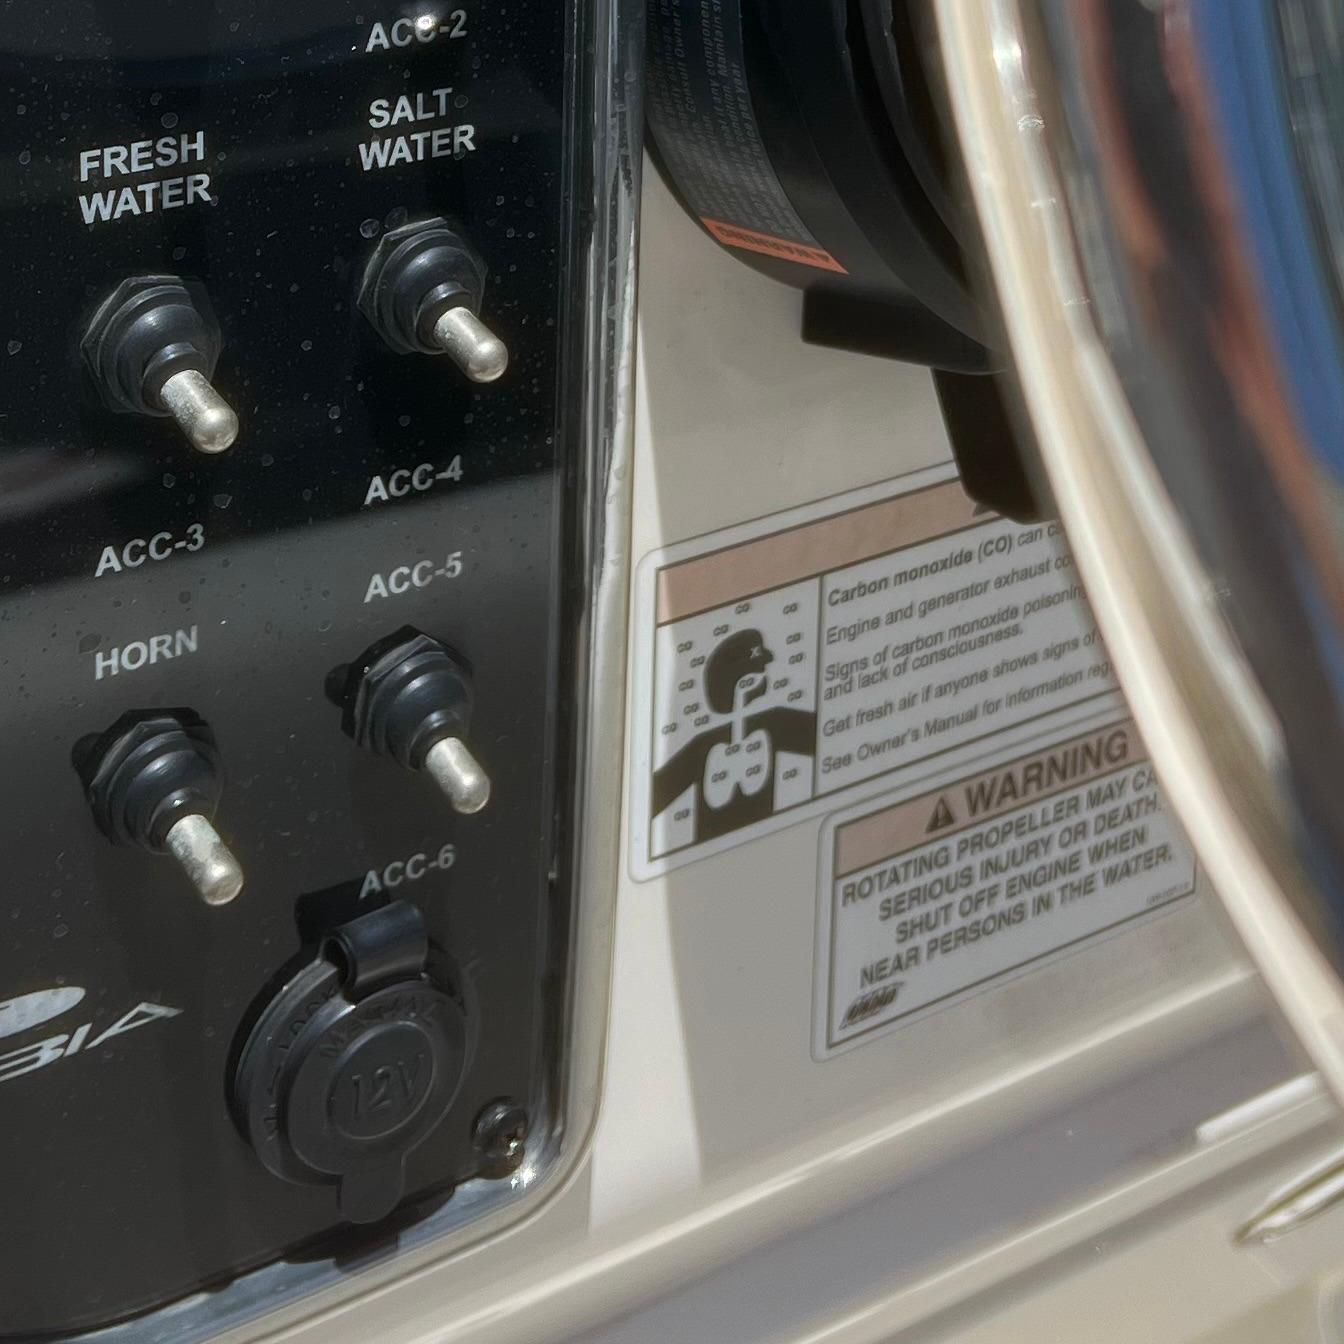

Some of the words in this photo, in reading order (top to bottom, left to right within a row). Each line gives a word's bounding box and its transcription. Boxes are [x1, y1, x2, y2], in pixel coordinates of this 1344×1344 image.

[365, 8, 469, 53] ACC-2
[368, 88, 453, 130] SALT
[77, 131, 206, 184] FRESH
[359, 123, 477, 172] WATER
[77, 172, 213, 225] WATER
[363, 455, 464, 506] ACC-4
[95, 523, 206, 578] ACC-3
[363, 552, 463, 602] ACC-5
[828, 576, 890, 607] Carbon
[893, 549, 974, 587] monoxide
[977, 534, 1014, 564] (CO)
[1016, 528, 1044, 548] can
[826, 616, 881, 645] Engine
[884, 603, 914, 626] and
[918, 579, 991, 619] generator
[993, 558, 1051, 590] exhaust
[95, 624, 199, 681] HORN
[819, 675, 854, 701] and
[858, 667, 889, 689] lack
[892, 658, 908, 678] of
[911, 623, 1024, 671] consciousness.
[825, 656, 869, 682] Signs
[872, 645, 889, 666] of
[891, 631, 944, 660] carbon
[948, 605, 1020, 640] monoxide
[822, 753, 853, 774] See
[857, 728, 921, 761] Owner's
[924, 704, 979, 737] Manual
[982, 698, 1003, 715] for
[1005, 669, 1084, 708] information
[1089, 656, 1113, 679] reg
[825, 714, 852, 737] Get
[855, 701, 894, 726] fresh
[898, 693, 919, 711] air
[921, 684, 932, 703] if
[934, 669, 989, 699] anyone
[992, 651, 1039, 678] shows
[1042, 637, 1080, 661] signs
[966, 731, 1130, 817] WARNING
[357, 843, 457, 897] ACC-6
[841, 846, 951, 908] ROTATING
[956, 795, 1080, 861] PROPELLER
[1086, 777, 1127, 809] MAY
[878, 865, 974, 922] SERIOUS
[979, 834, 1052, 881] INJURY
[1058, 820, 1088, 849] OR
[1094, 790, 1163, 835] DEATH.
[860, 946, 920, 988] NEAR
[926, 902, 1027, 961] PERSONS
[1032, 893, 1053, 916] IN
[1059, 873, 1096, 904] THE
[1102, 843, 1173, 886] WATER.
[895, 902, 954, 945] SHUT
[958, 883, 999, 918] OFF
[1005, 850, 1081, 899] ENGINE
[1087, 825, 1147, 865] WHEN
[351, 1053, 425, 1117] 12V
